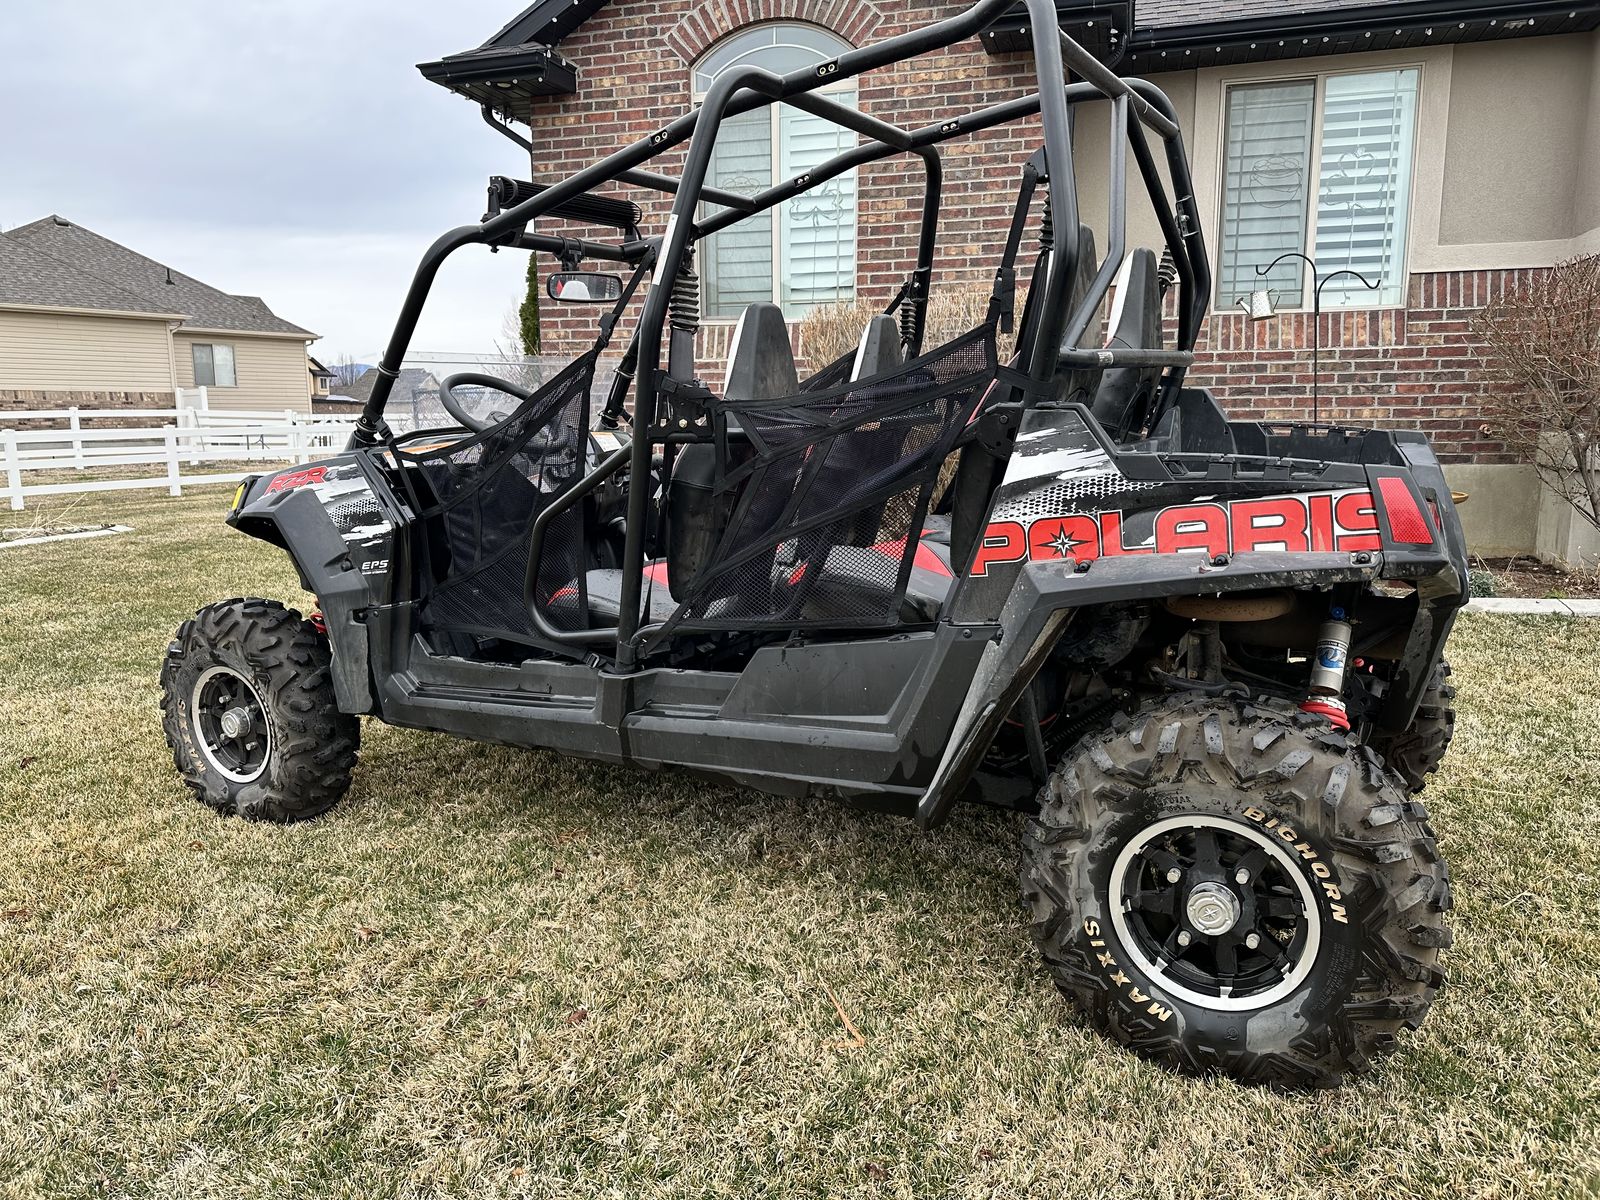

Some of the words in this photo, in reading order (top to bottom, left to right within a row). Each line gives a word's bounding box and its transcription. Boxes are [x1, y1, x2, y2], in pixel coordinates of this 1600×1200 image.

[264, 466, 327, 496] RZR
[361, 559, 389, 570] EPS
[969, 489, 1383, 577] POLARIS
[1243, 806, 1349, 924] BIGHORN
[1084, 920, 1174, 1022] MAXXIS
